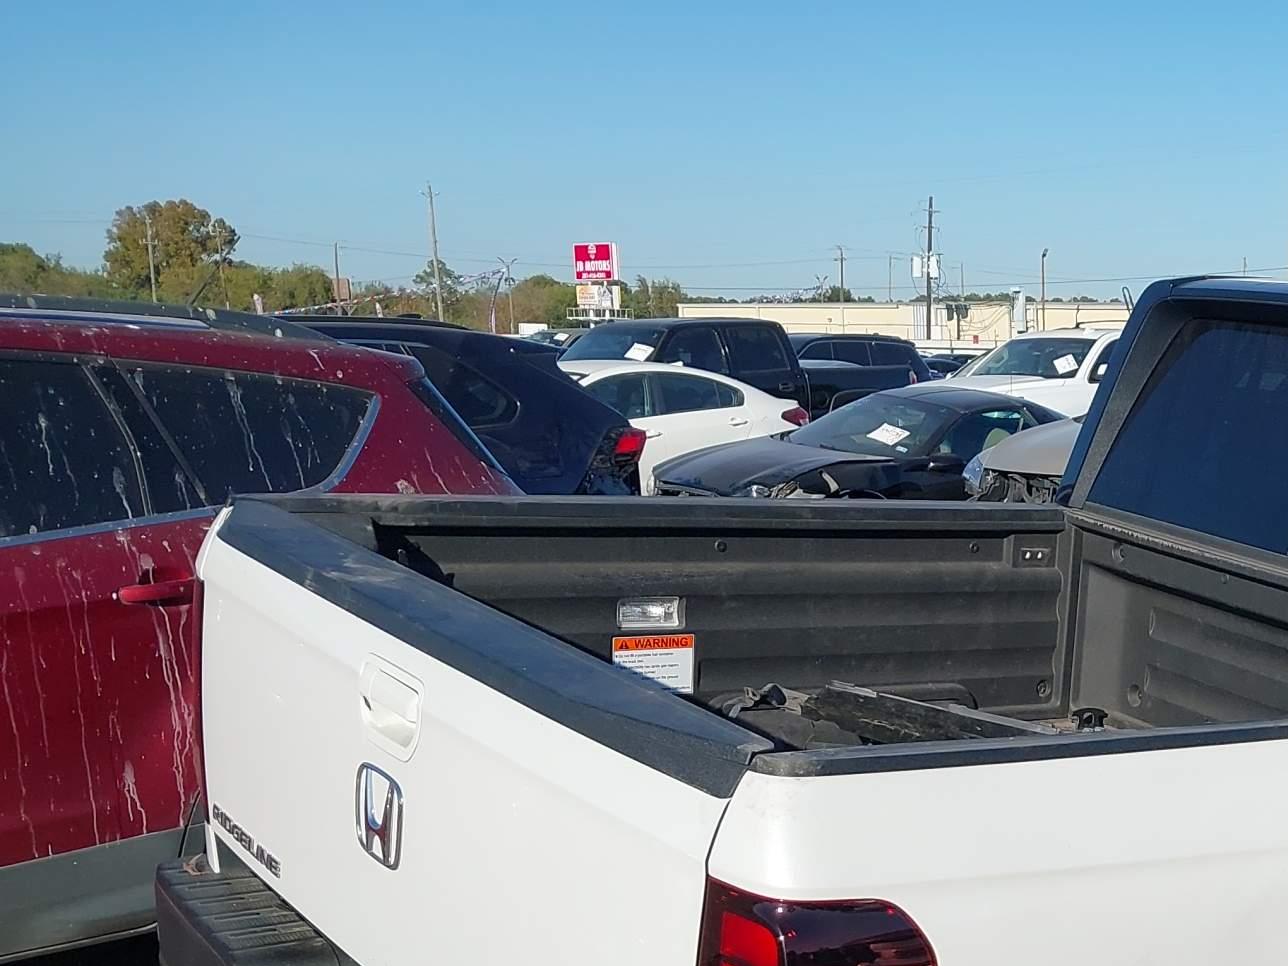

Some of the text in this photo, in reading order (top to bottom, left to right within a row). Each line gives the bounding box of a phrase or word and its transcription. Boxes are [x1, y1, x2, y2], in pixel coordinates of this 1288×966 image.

[585, 260, 610, 272] MOTORS
[634, 637, 689, 649] WARNING
[213, 803, 281, 878] RIDGELINE
